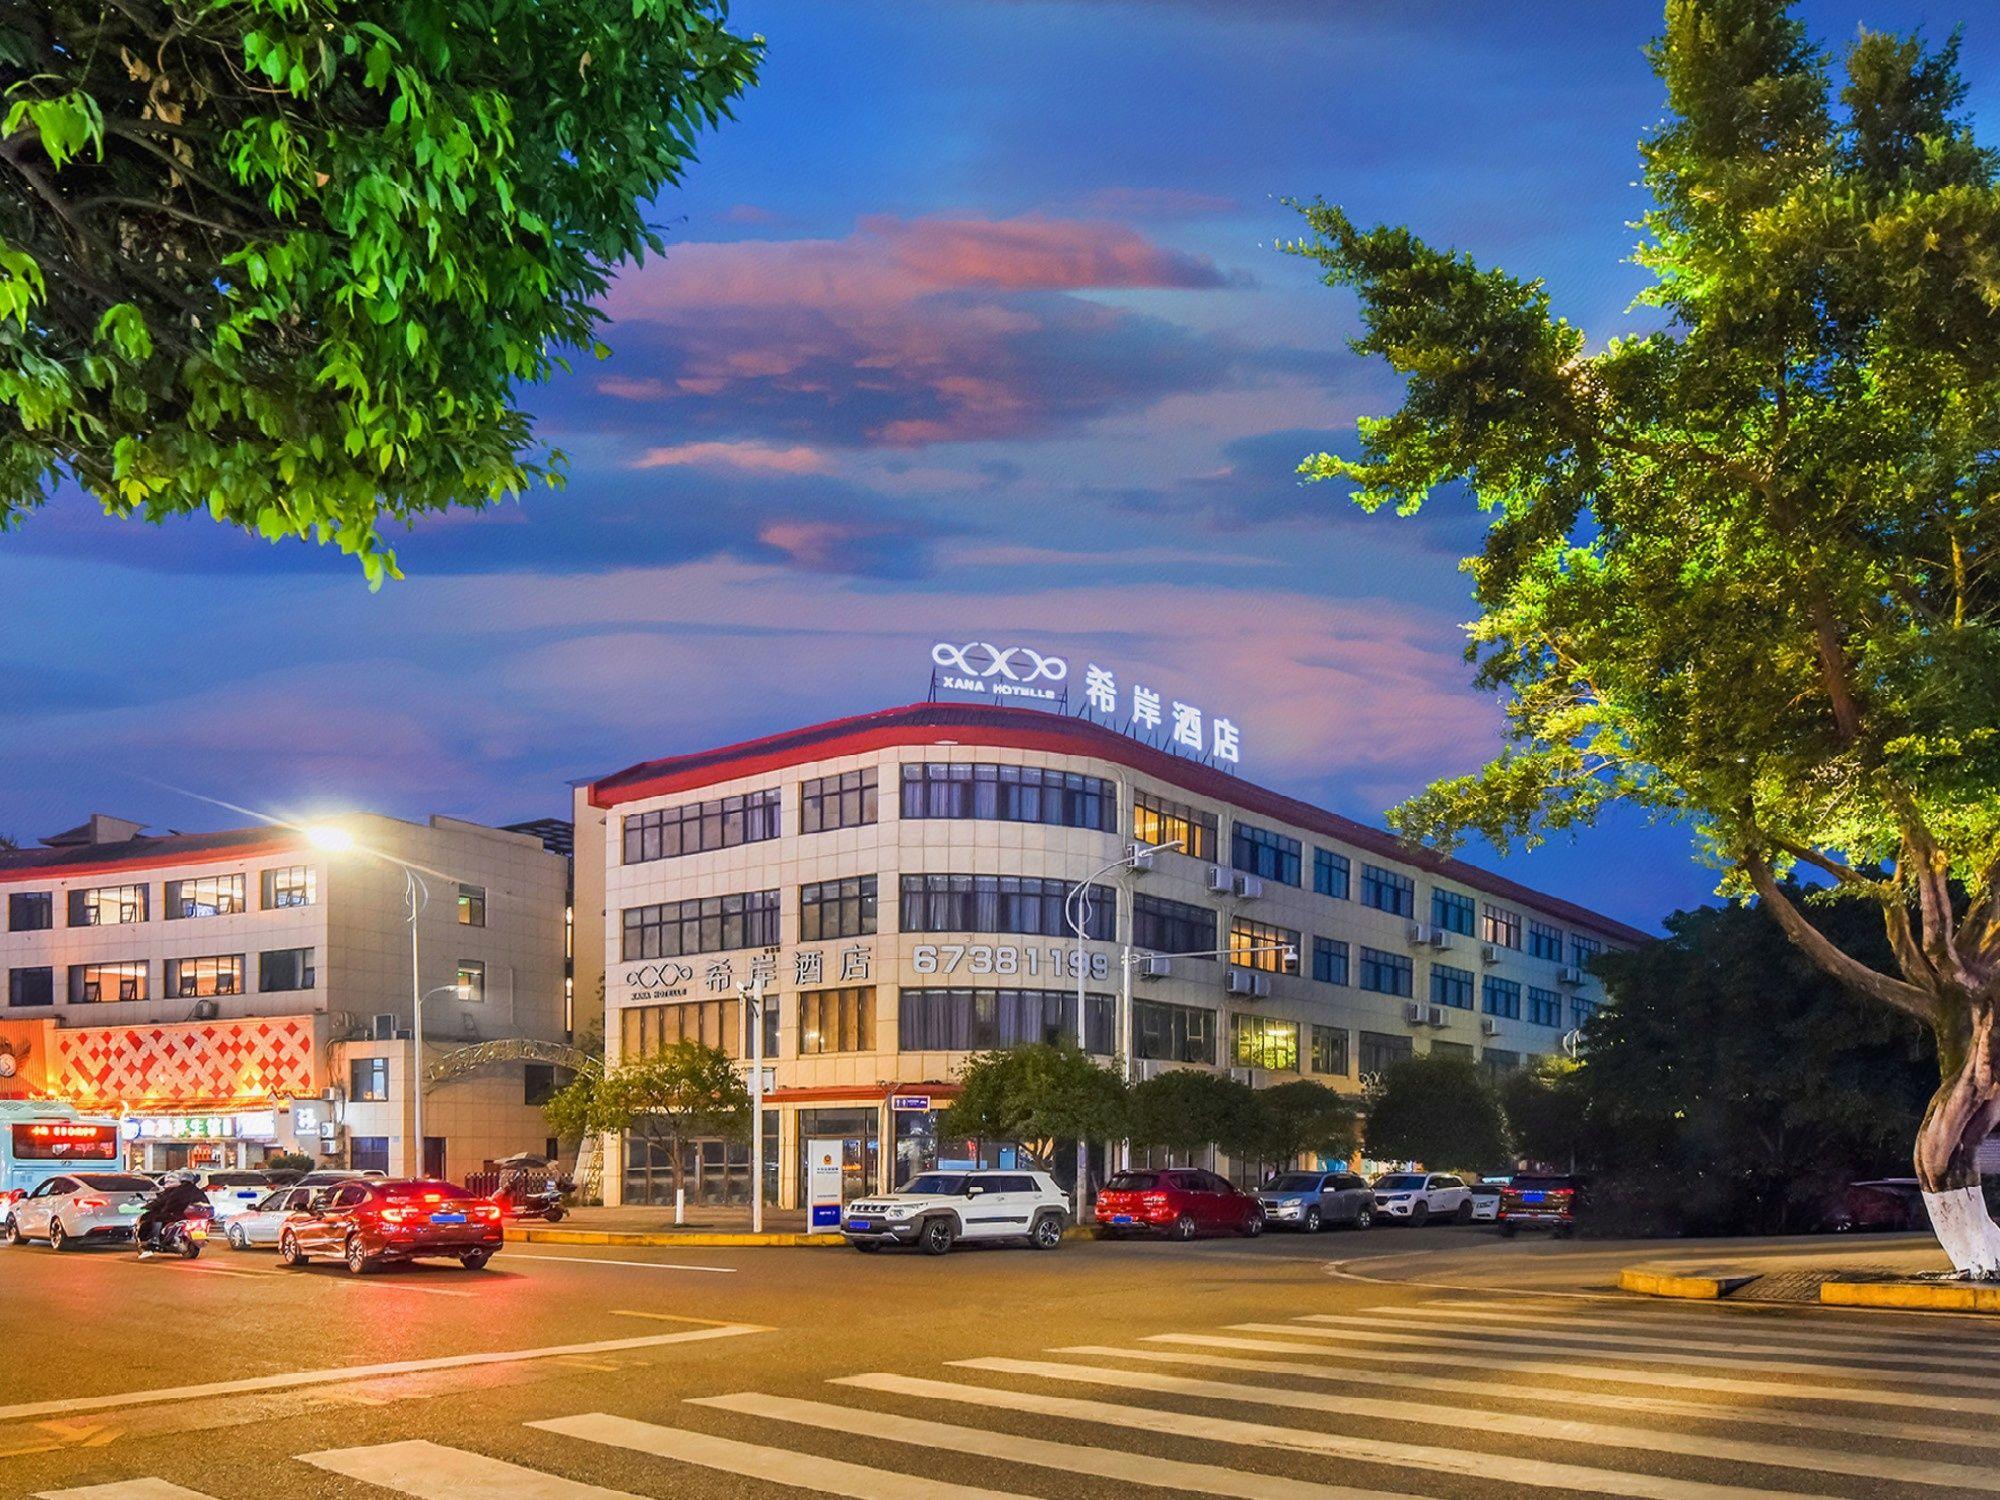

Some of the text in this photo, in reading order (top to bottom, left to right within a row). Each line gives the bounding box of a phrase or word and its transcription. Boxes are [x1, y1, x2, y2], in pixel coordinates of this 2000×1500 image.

[943, 676, 985, 692] XANA
[1086, 663, 1239, 763] 希岸酒店
[706, 945, 871, 993] 希岸酒店
[912, 944, 1109, 980] 67381199
